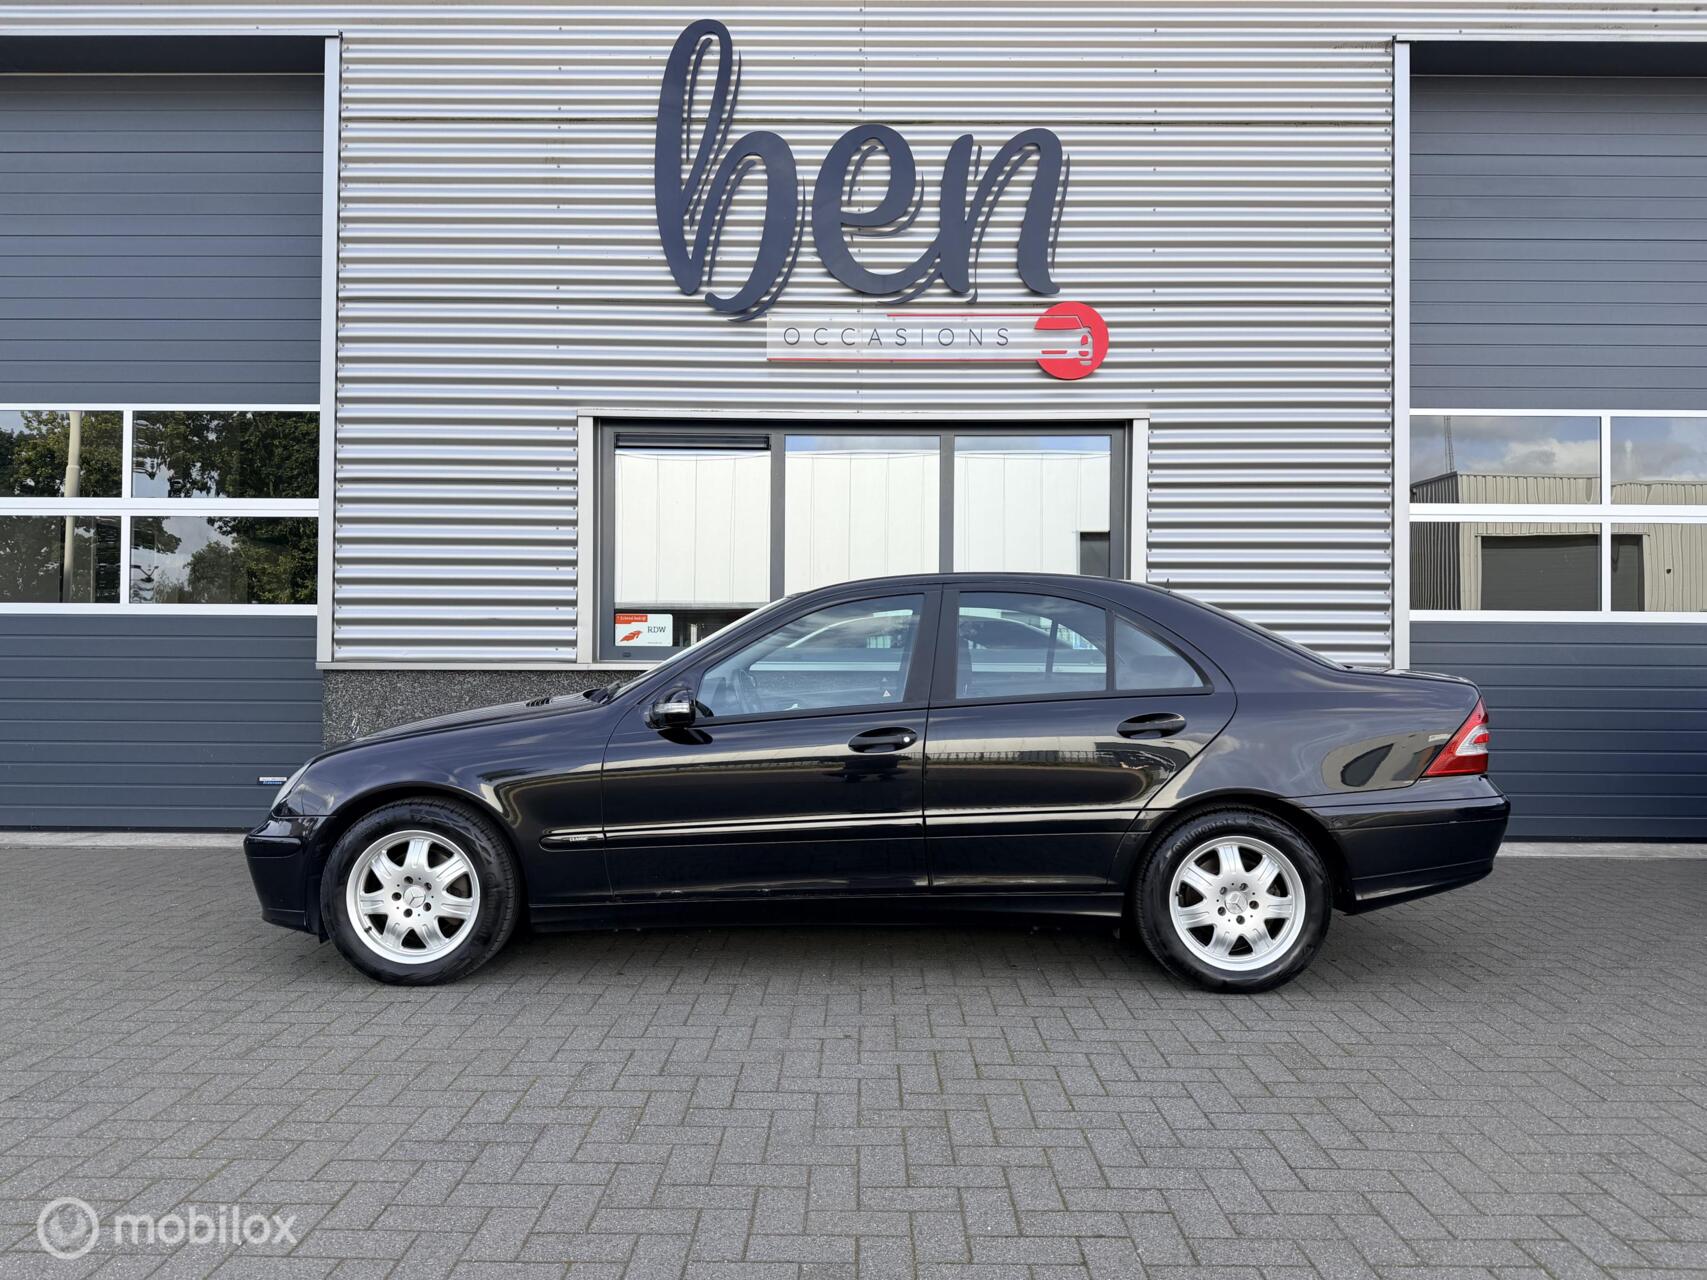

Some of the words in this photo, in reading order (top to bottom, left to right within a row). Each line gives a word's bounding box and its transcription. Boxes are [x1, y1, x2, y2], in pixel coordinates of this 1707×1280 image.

[655, 18, 1070, 321] ben
[783, 326, 1010, 346] OCCASIONS
[647, 625, 666, 633] RDW
